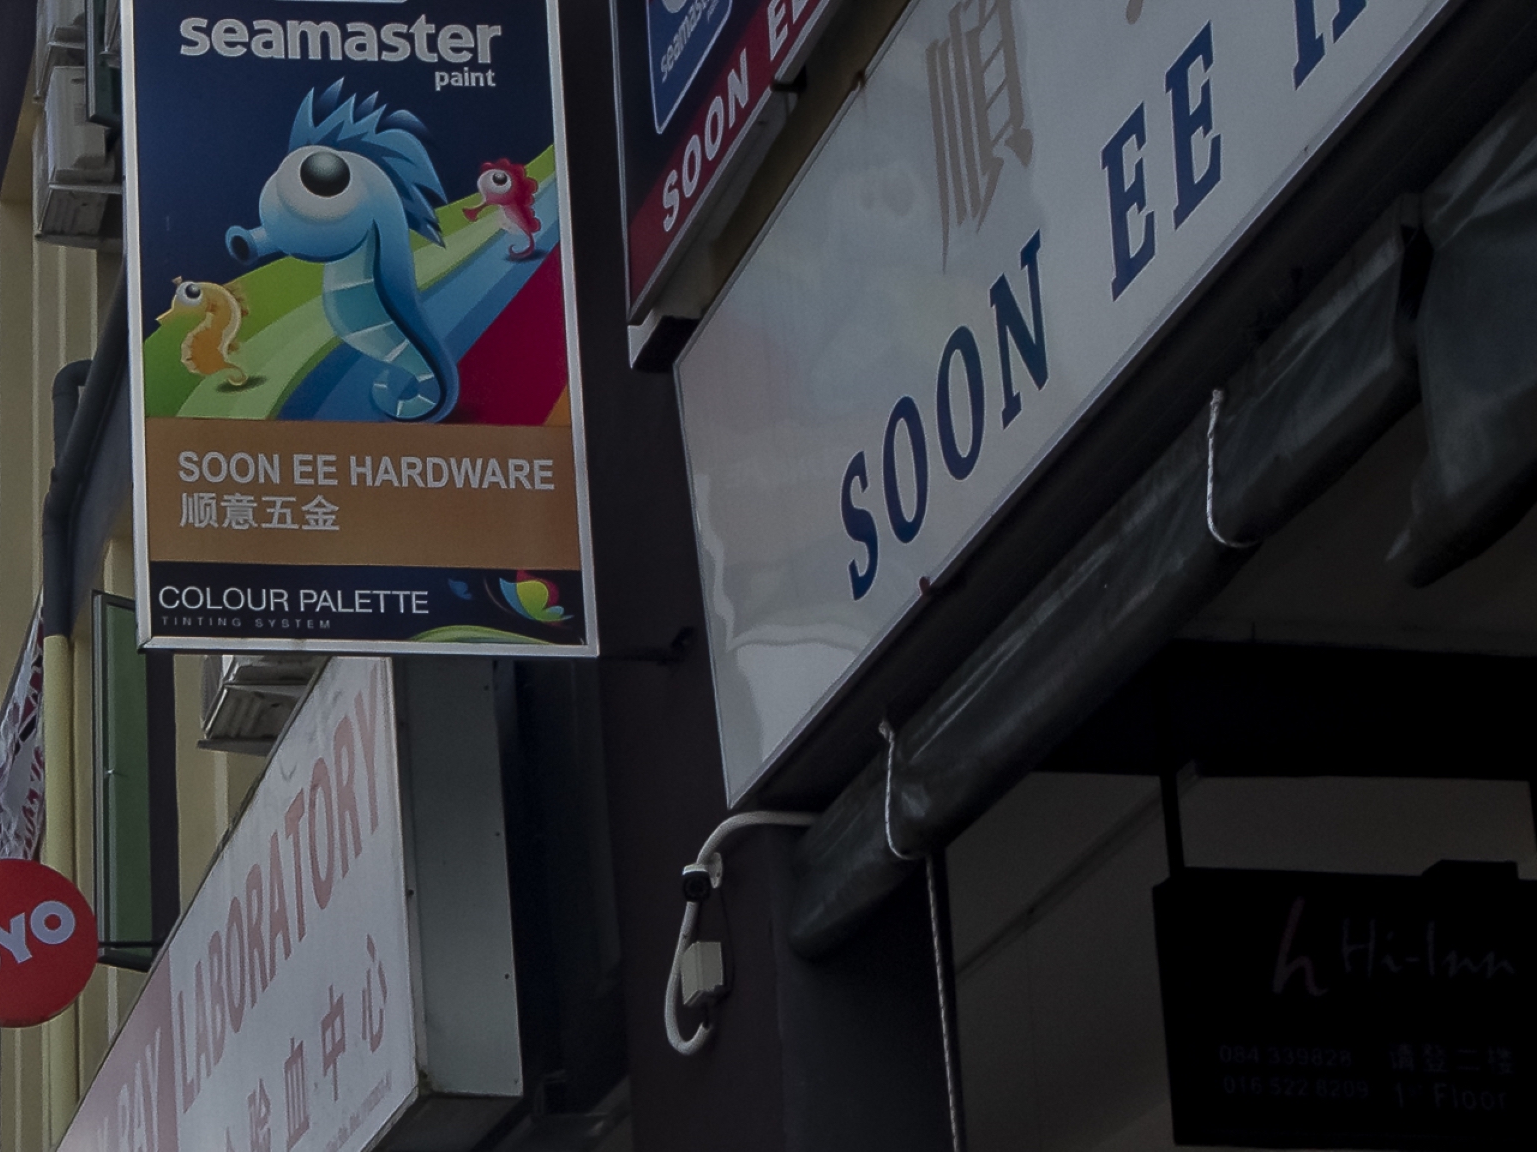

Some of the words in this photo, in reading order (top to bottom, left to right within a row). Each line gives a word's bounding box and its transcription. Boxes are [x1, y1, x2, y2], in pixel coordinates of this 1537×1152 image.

[179, 14, 502, 64] seamaster
[434, 67, 497, 91] paint
[662, 47, 749, 232] SOON
[840, 229, 1051, 601] SOON
[1100, 19, 1223, 302] EE
[178, 450, 281, 485] SOON
[293, 453, 339, 486] EE
[349, 454, 555, 490] HARDWARE
[179, 492, 340, 531] 顺意五金
[158, 585, 289, 612] COLOUR
[299, 589, 430, 614] PALETTE
[161, 615, 243, 628] TINTING
[254, 617, 331, 629] SYSTEM
[173, 690, 381, 1114] LABORATORY
